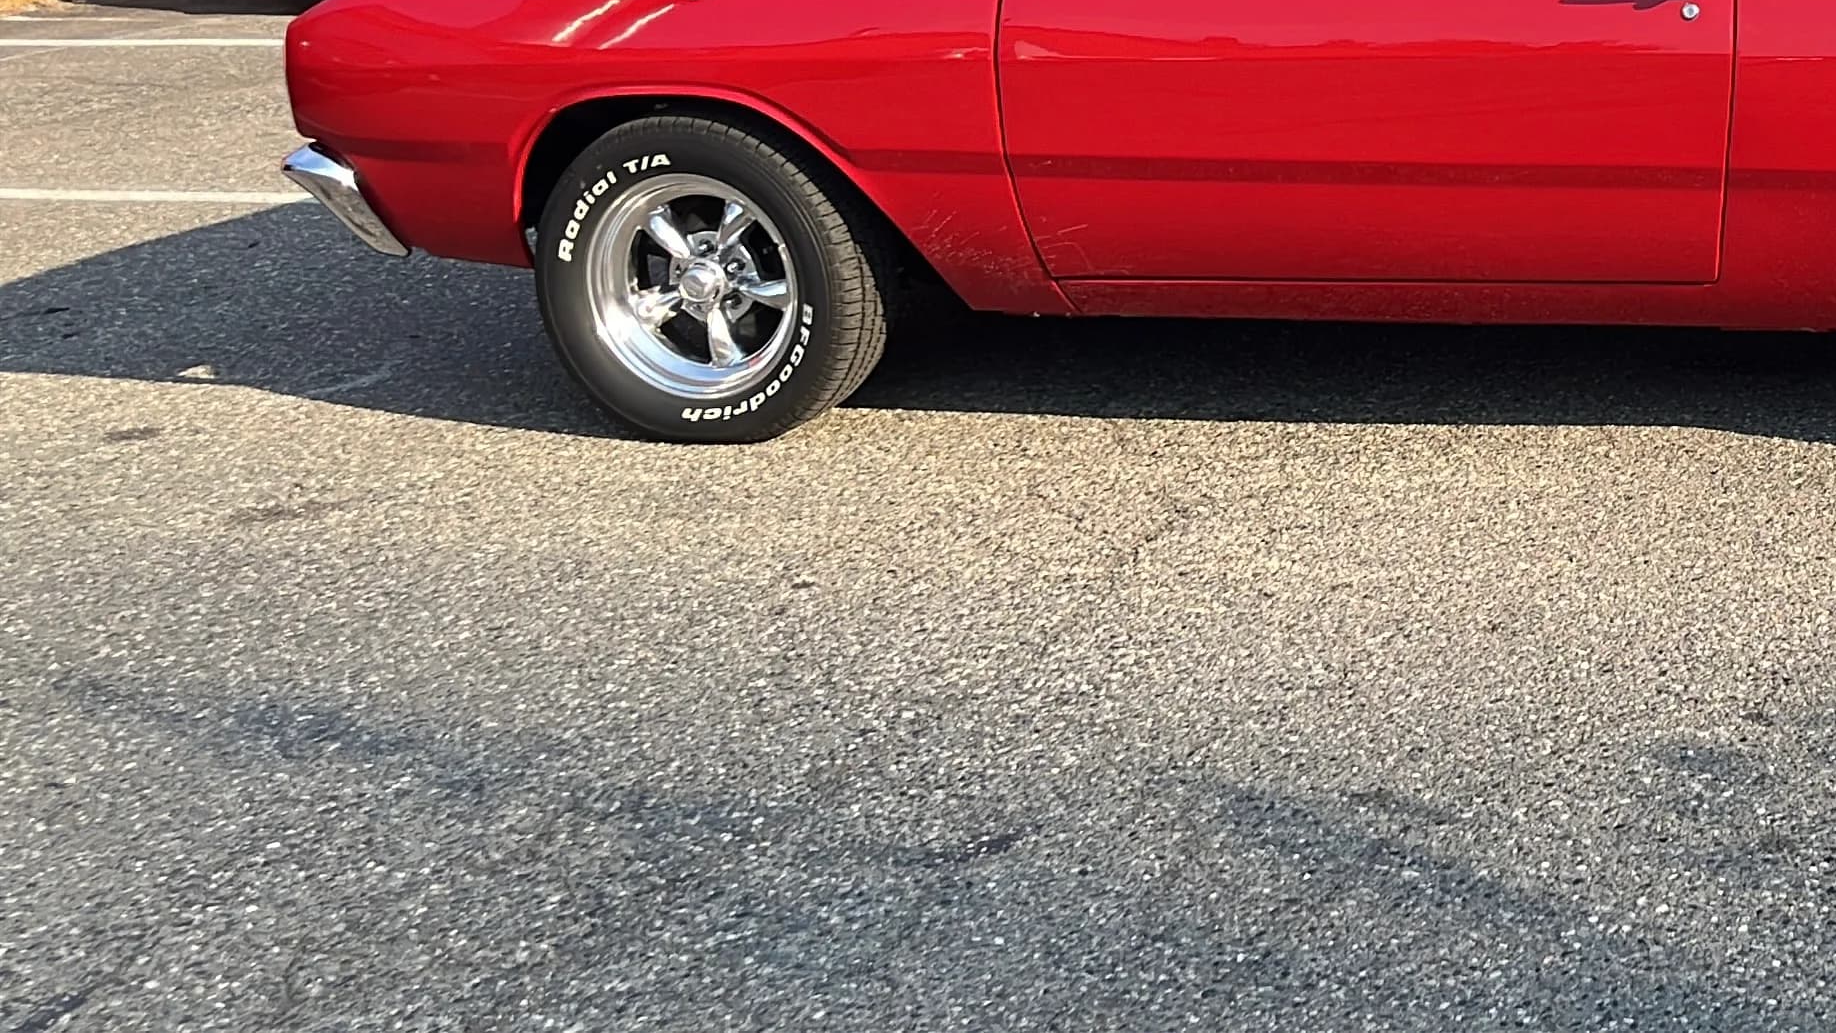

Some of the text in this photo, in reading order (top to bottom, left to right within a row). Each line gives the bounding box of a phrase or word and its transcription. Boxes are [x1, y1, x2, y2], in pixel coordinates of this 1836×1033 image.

[557, 152, 672, 262] Radial T/A
[681, 303, 815, 423] BFGoodrich
